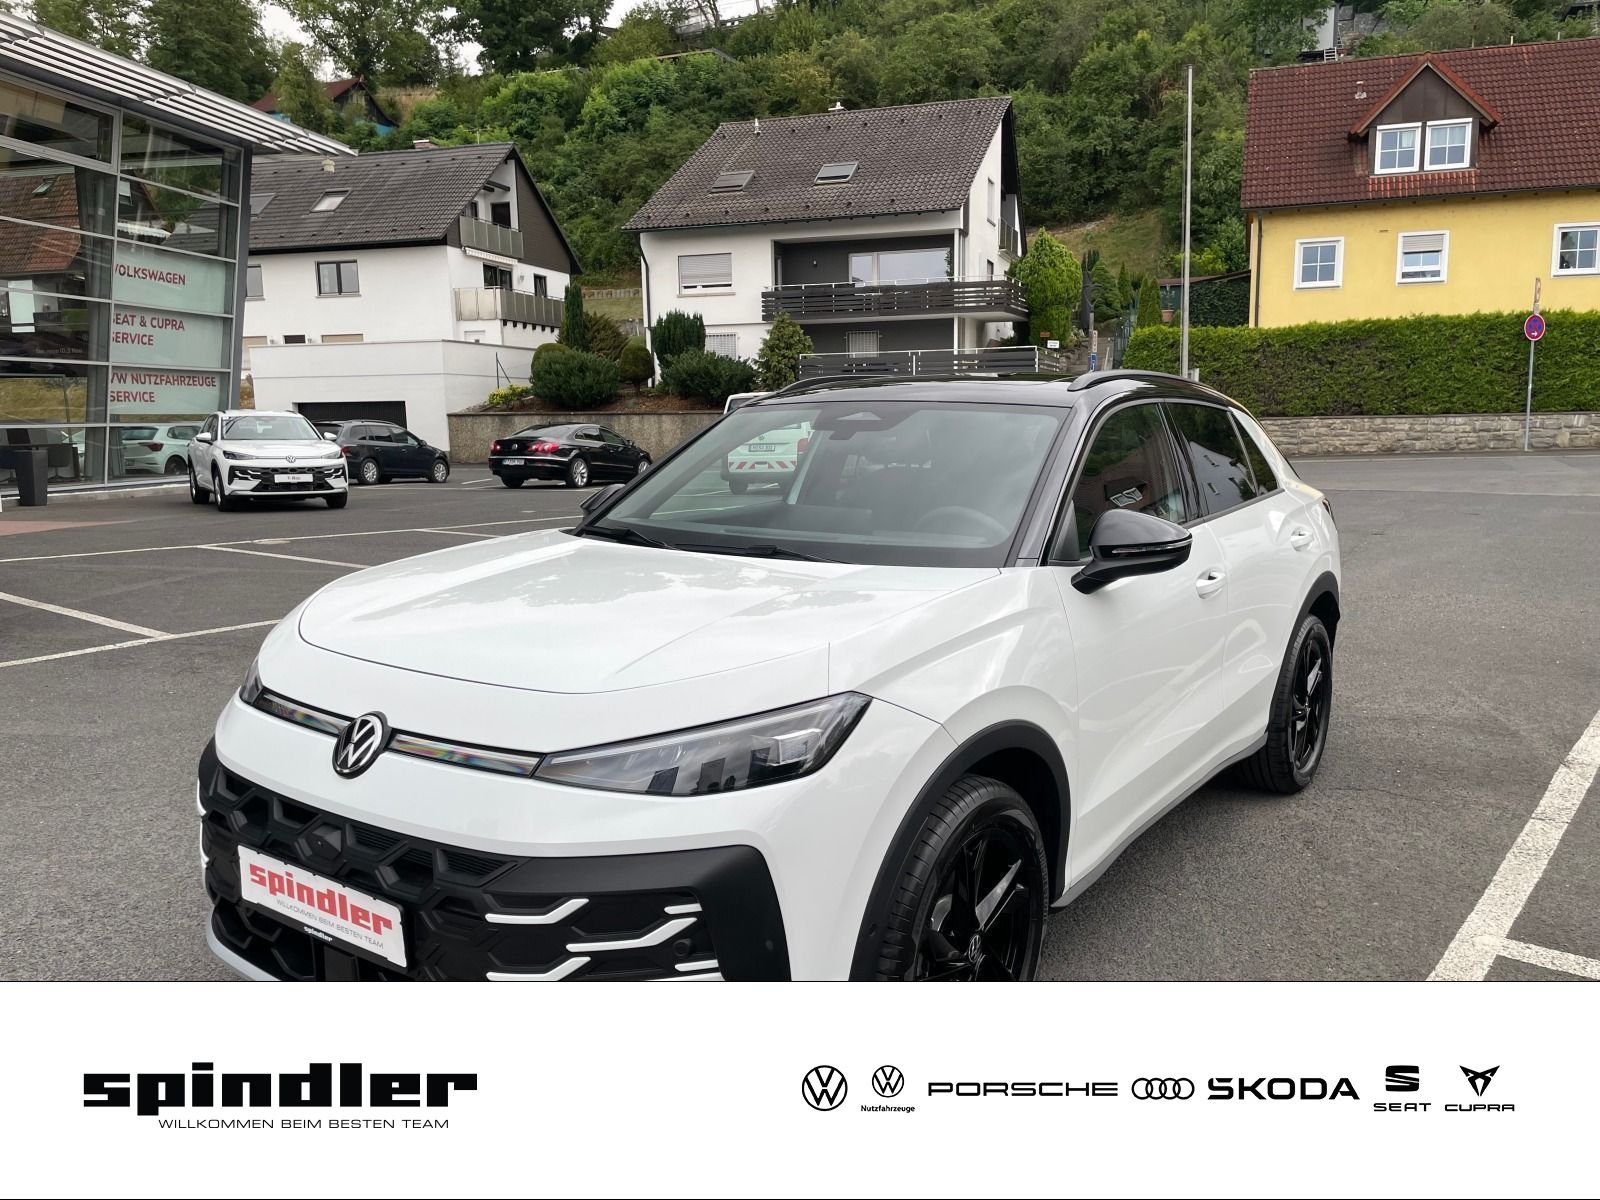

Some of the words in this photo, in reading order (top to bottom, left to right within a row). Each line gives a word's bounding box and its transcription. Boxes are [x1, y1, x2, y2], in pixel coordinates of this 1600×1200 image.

[113, 313, 136, 326] EAT
[140, 315, 147, 327] &
[150, 317, 185, 331] CUPRA
[112, 331, 154, 346] ERVICE
[131, 373, 217, 387] NUTZFAHRZEUGE
[110, 390, 155, 403] SERVICE
[249, 863, 393, 936] spindler
[276, 898, 318, 921] WILLKOMMEN
[318, 915, 335, 929] BEIM
[336, 922, 363, 941] BESTEN
[364, 935, 384, 950] TEAM
[304, 926, 333, 942] spindler
